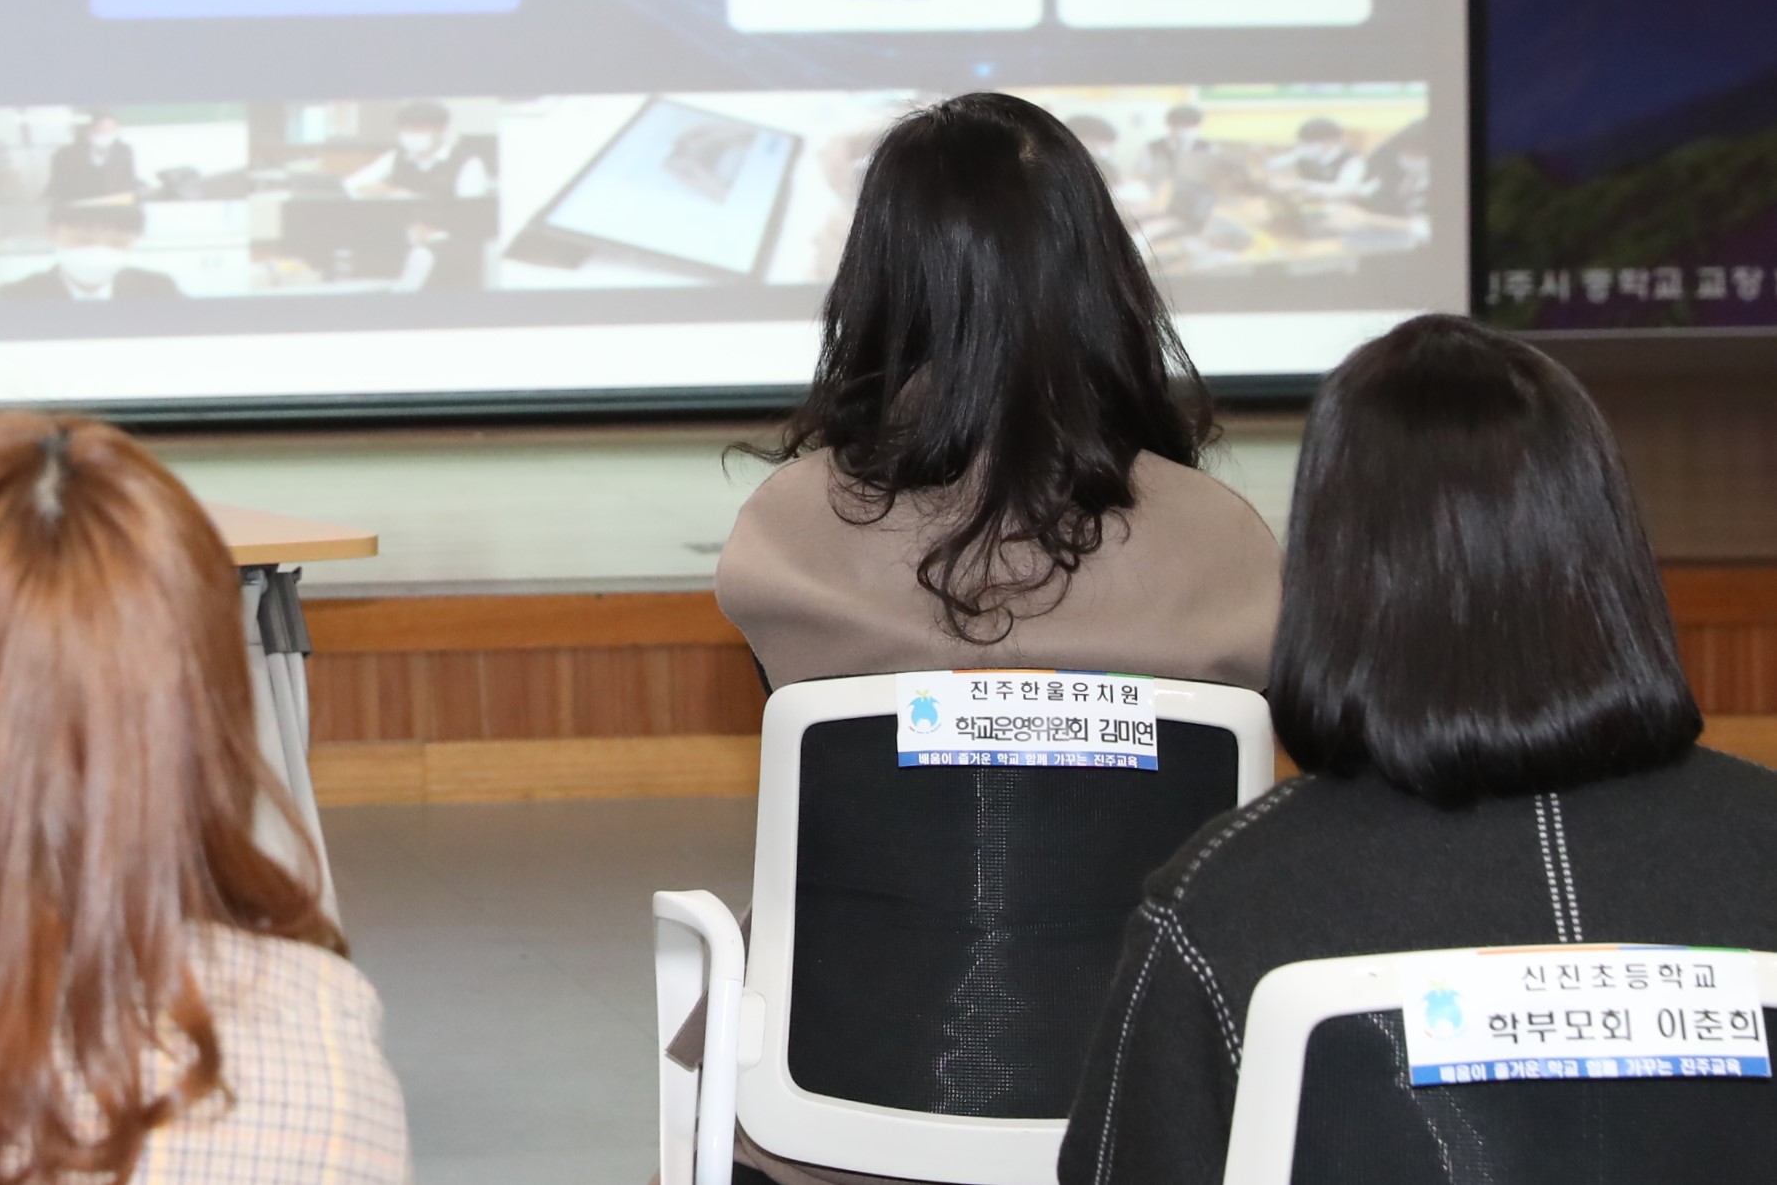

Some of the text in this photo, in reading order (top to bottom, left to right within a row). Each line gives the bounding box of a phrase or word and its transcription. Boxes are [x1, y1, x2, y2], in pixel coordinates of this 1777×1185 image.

[969, 680, 1139, 706] 진주한울유치원
[954, 715, 1155, 747] 학교운영위원회 김미연
[1521, 962, 1718, 993] 신진초등학교
[1487, 1007, 1761, 1045] 학부모회 이춘희
